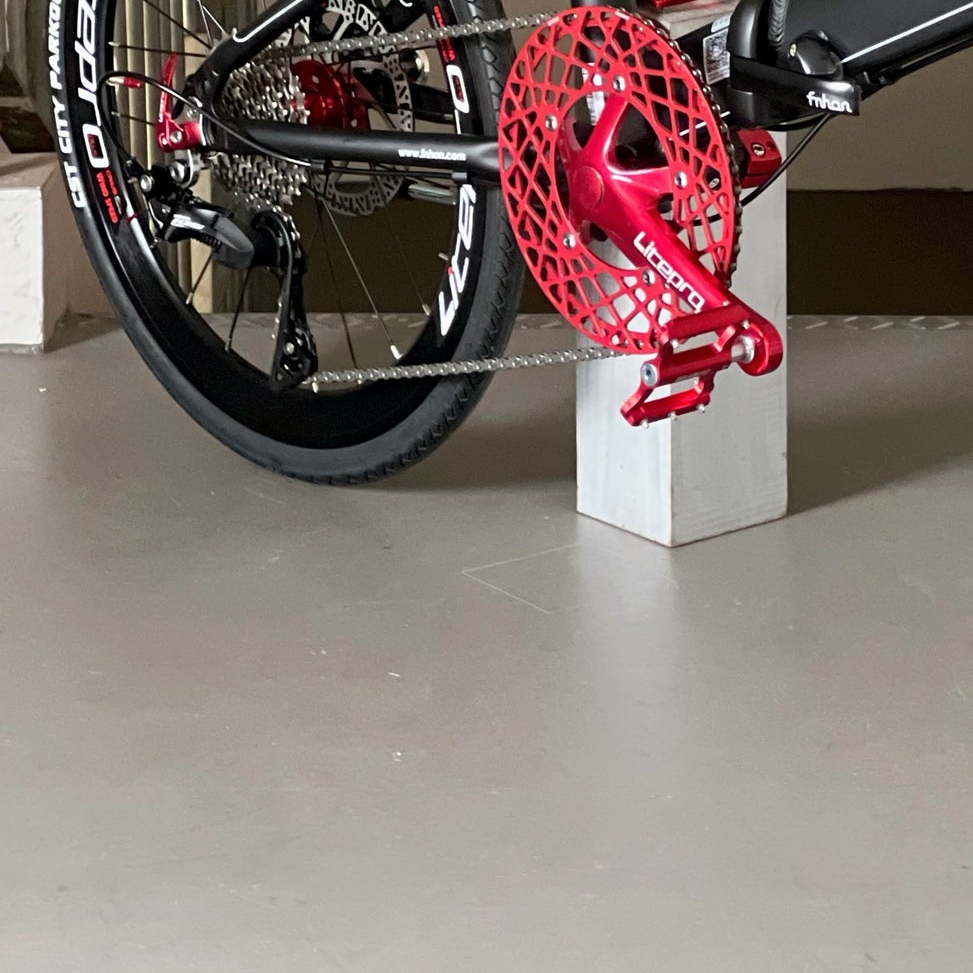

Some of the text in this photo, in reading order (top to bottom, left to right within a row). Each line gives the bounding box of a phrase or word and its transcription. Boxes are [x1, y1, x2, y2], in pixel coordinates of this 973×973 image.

[52, 95, 72, 154] CITY
[806, 90, 853, 113] fnhon
[64, 164, 87, 208] CST
[633, 231, 705, 314] Litepro
